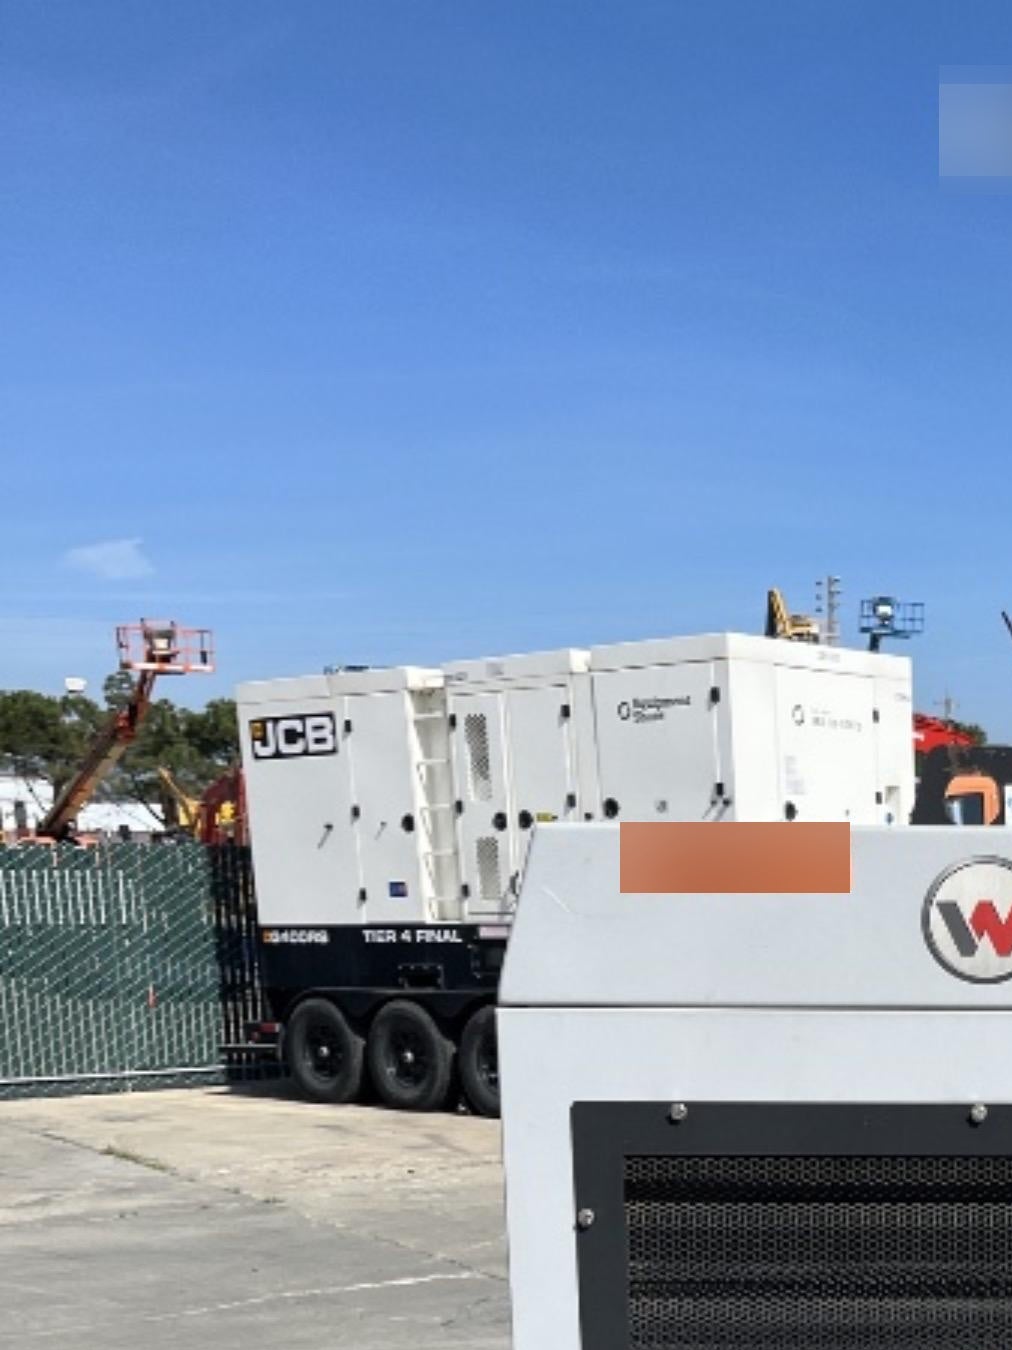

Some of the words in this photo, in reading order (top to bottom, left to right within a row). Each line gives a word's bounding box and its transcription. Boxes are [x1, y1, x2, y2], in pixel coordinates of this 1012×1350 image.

[253, 715, 335, 757] JCB
[362, 929, 396, 943] TIER
[400, 929, 412, 943] 4
[415, 928, 463, 943] FINAL
